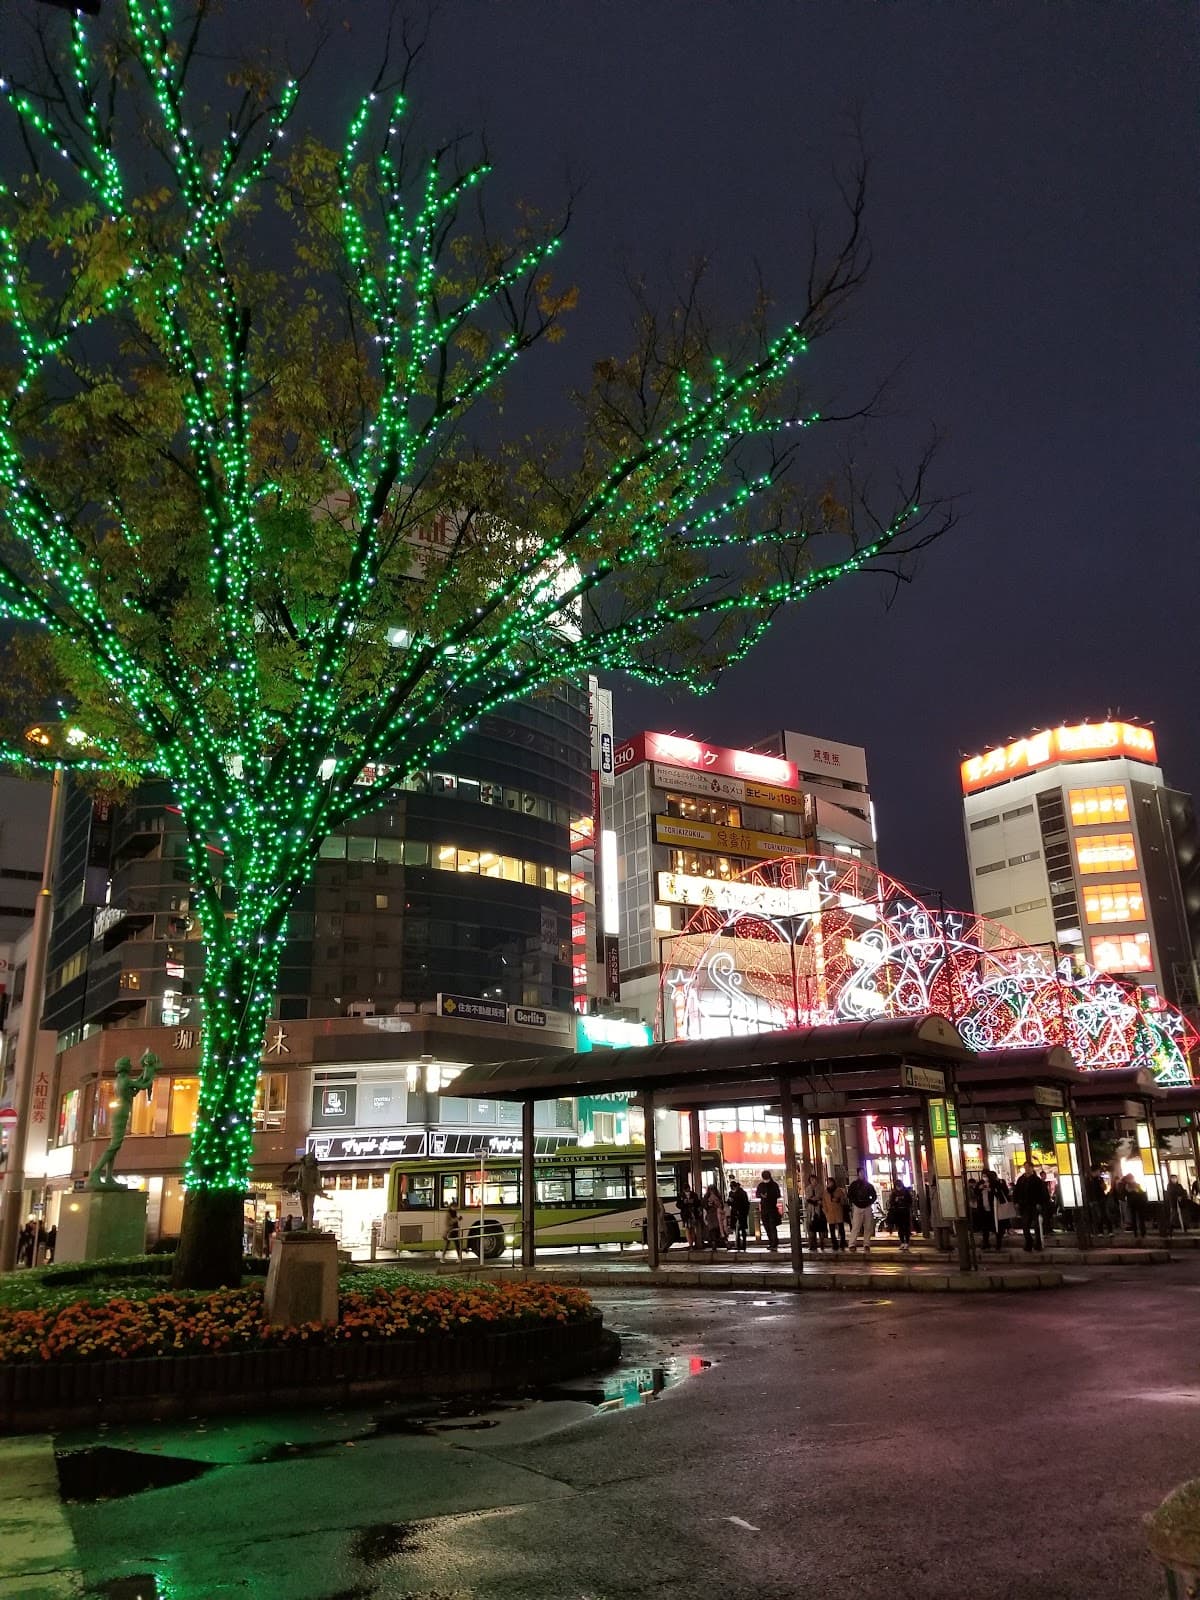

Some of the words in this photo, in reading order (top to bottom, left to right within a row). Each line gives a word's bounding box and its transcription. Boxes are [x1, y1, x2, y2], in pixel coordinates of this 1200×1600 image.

[602, 736, 612, 771] Berlitz
[614, 747, 635, 766] CHO
[746, 787, 776, 801] 生ビール
[664, 826, 701, 838] TORIKIZOKU
[717, 830, 752, 852] 鳥貴族
[517, 1010, 545, 1024] Berlitz
[33, 1071, 48, 1123] 大和証券
